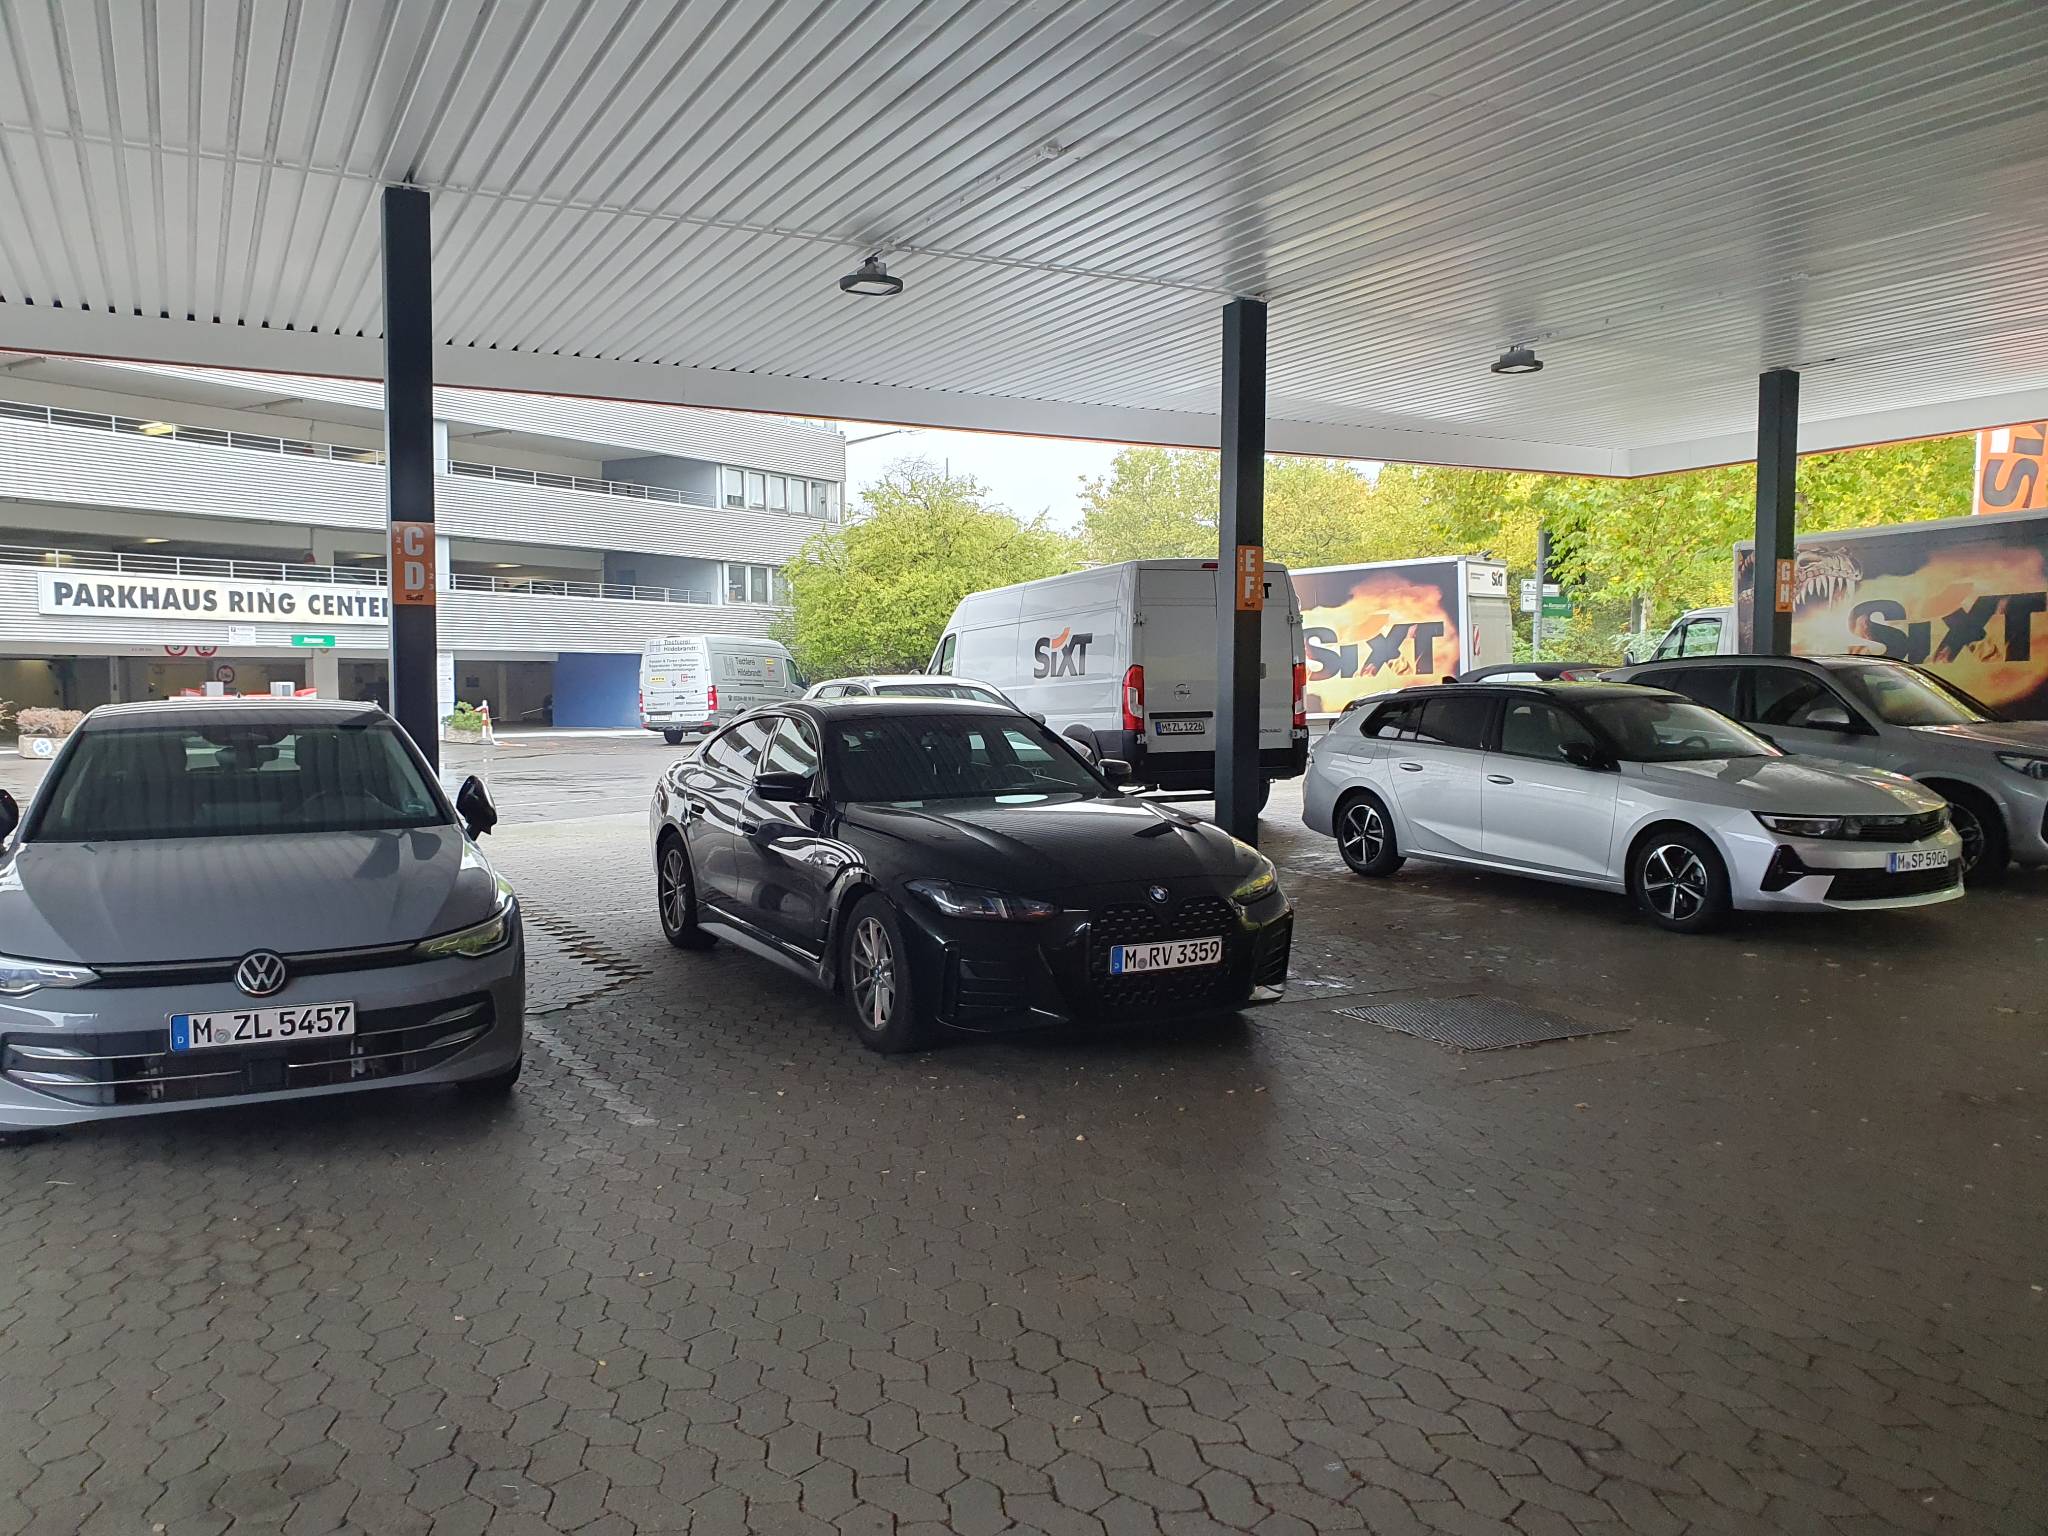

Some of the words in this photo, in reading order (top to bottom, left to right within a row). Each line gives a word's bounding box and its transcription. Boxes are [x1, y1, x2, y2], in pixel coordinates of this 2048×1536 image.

[404, 527, 424, 556] C
[1246, 550, 1256, 572] E
[405, 562, 425, 590] D
[1245, 576, 1255, 598] F
[53, 581, 217, 612] PARKHAUS
[228, 590, 296, 614] RING
[1161, 723, 1168, 732] M
[1172, 722, 1183, 731] ZL
[1184, 722, 1203, 731] 1226
[1897, 854, 1905, 869] M
[1911, 853, 1924, 868] SP
[1925, 851, 1947, 866] 5906
[1125, 949, 1137, 970] M
[1149, 945, 1173, 967] RV
[1176, 940, 1220, 965] 3359
[177, 1036, 184, 1044] D
[192, 1017, 212, 1044] M
[233, 1014, 272, 1041] ZL
[279, 1006, 351, 1037] 5457
